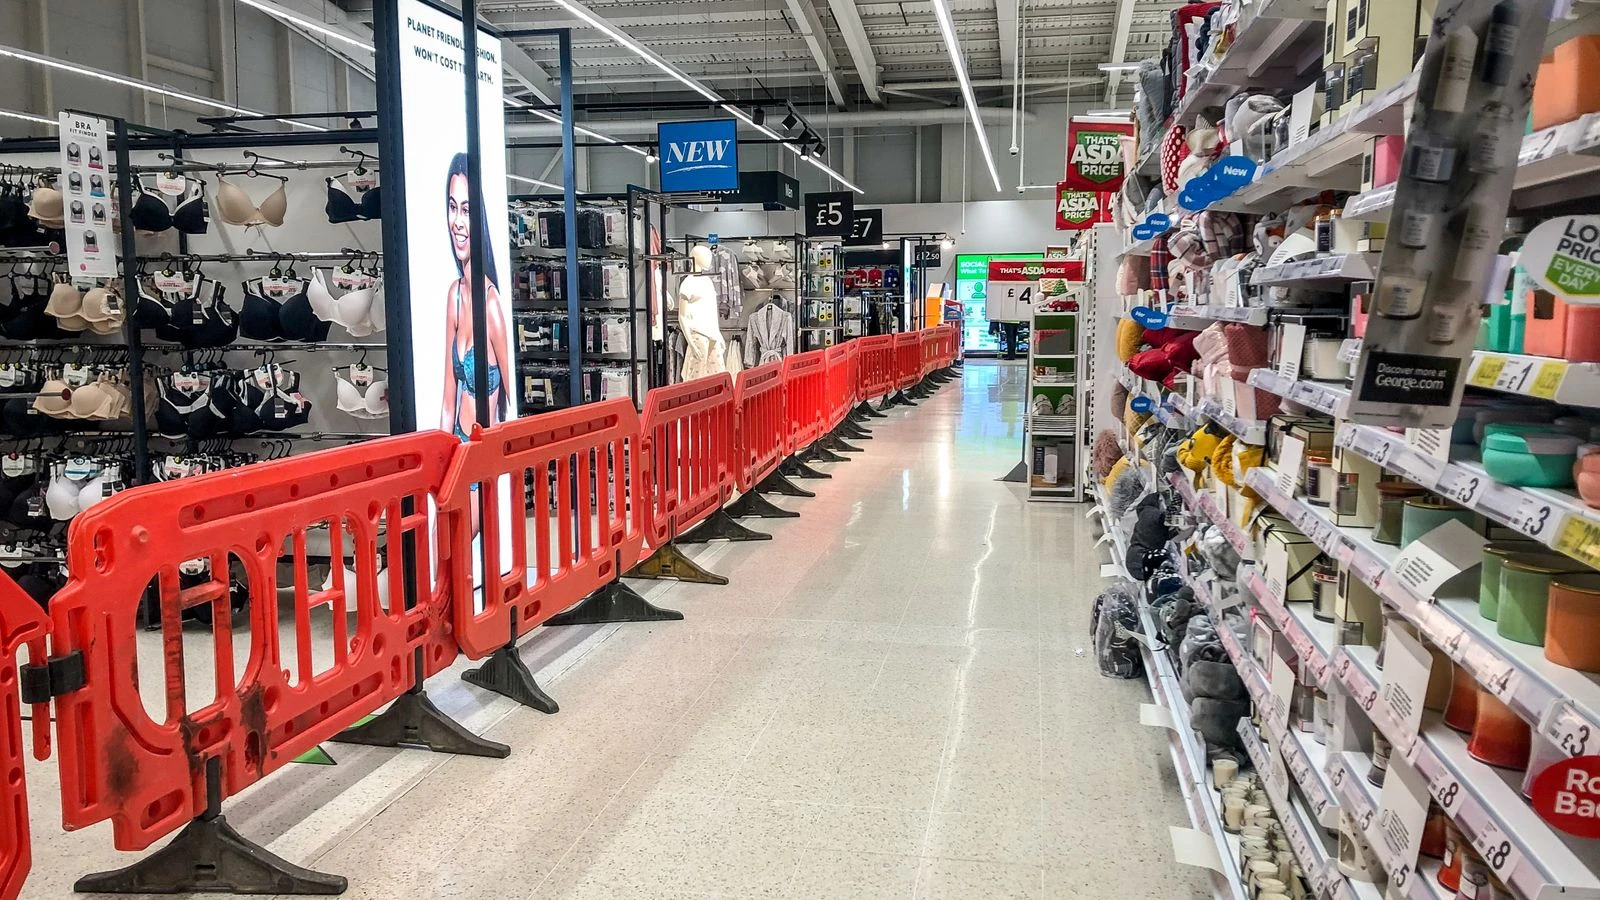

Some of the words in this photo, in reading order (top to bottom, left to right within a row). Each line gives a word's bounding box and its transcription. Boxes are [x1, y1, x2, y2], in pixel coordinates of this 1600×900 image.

[407, 17, 435, 39] PLANET
[436, 30, 465, 51] FRIENDL
[476, 46, 498, 64] SHION.
[413, 45, 439, 64] WON'T
[439, 56, 457, 71] COST
[75, 121, 91, 131] BRA
[78, 129, 98, 138] FINDER
[665, 139, 731, 164] NEW
[1084, 135, 1118, 146] THAT'S
[1081, 165, 1119, 176] PRICE
[1223, 165, 1248, 177] New
[1057, 196, 1099, 213] ASDA
[1066, 191, 1090, 199] THAT'S
[816, 202, 843, 226] £5
[1064, 210, 1091, 220] PRICE
[1563, 218, 1600, 244] LO
[1021, 266, 1046, 275] ASDA
[1557, 273, 1590, 291] DAY
[1377, 362, 1414, 375] Discover
[1415, 368, 1437, 377] more
[1438, 369, 1448, 378] at
[1506, 362, 1534, 392] £1
[1375, 374, 1445, 392] George.com
[1456, 477, 1479, 503] £3
[1522, 505, 1551, 536] £3
[1487, 667, 1515, 695] £4
[1560, 724, 1591, 758] £3
[1437, 781, 1459, 808] £8
[1485, 840, 1511, 870] £8
[1391, 863, 1410, 888] £5
